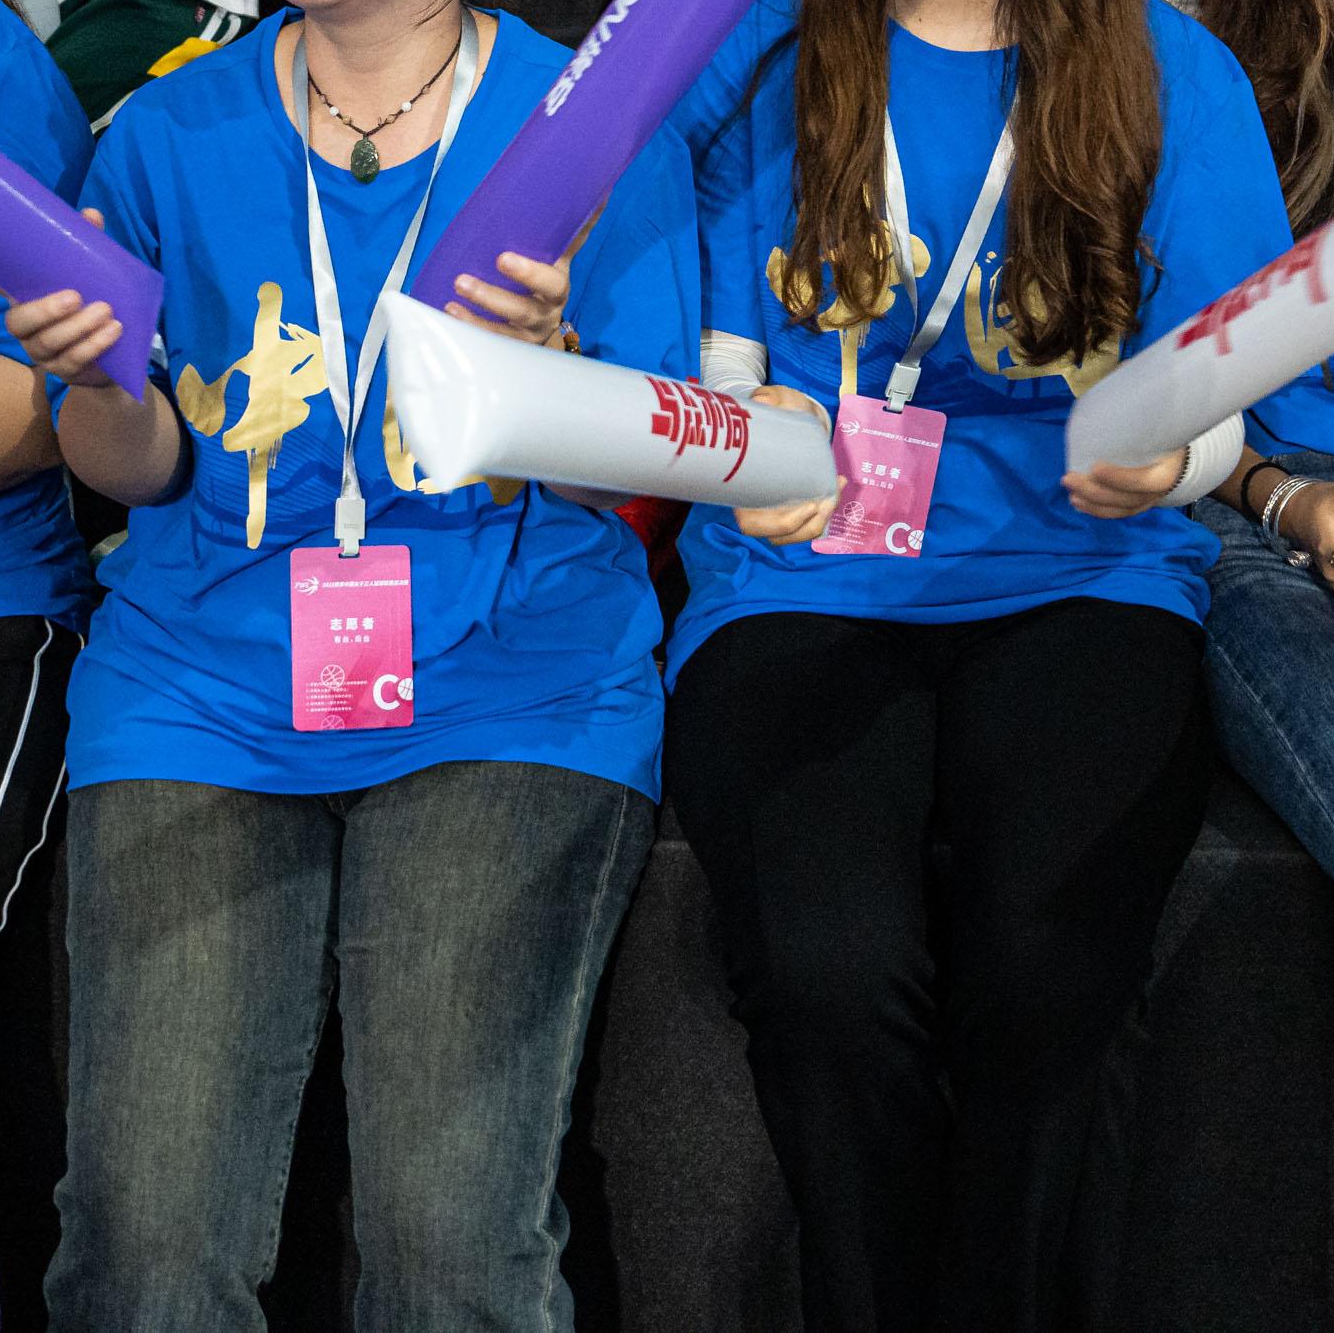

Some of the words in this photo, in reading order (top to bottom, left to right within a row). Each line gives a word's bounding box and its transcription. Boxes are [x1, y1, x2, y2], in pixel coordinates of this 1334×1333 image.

[860, 461, 902, 480] 志愿者
[329, 617, 375, 632] 志愿者
